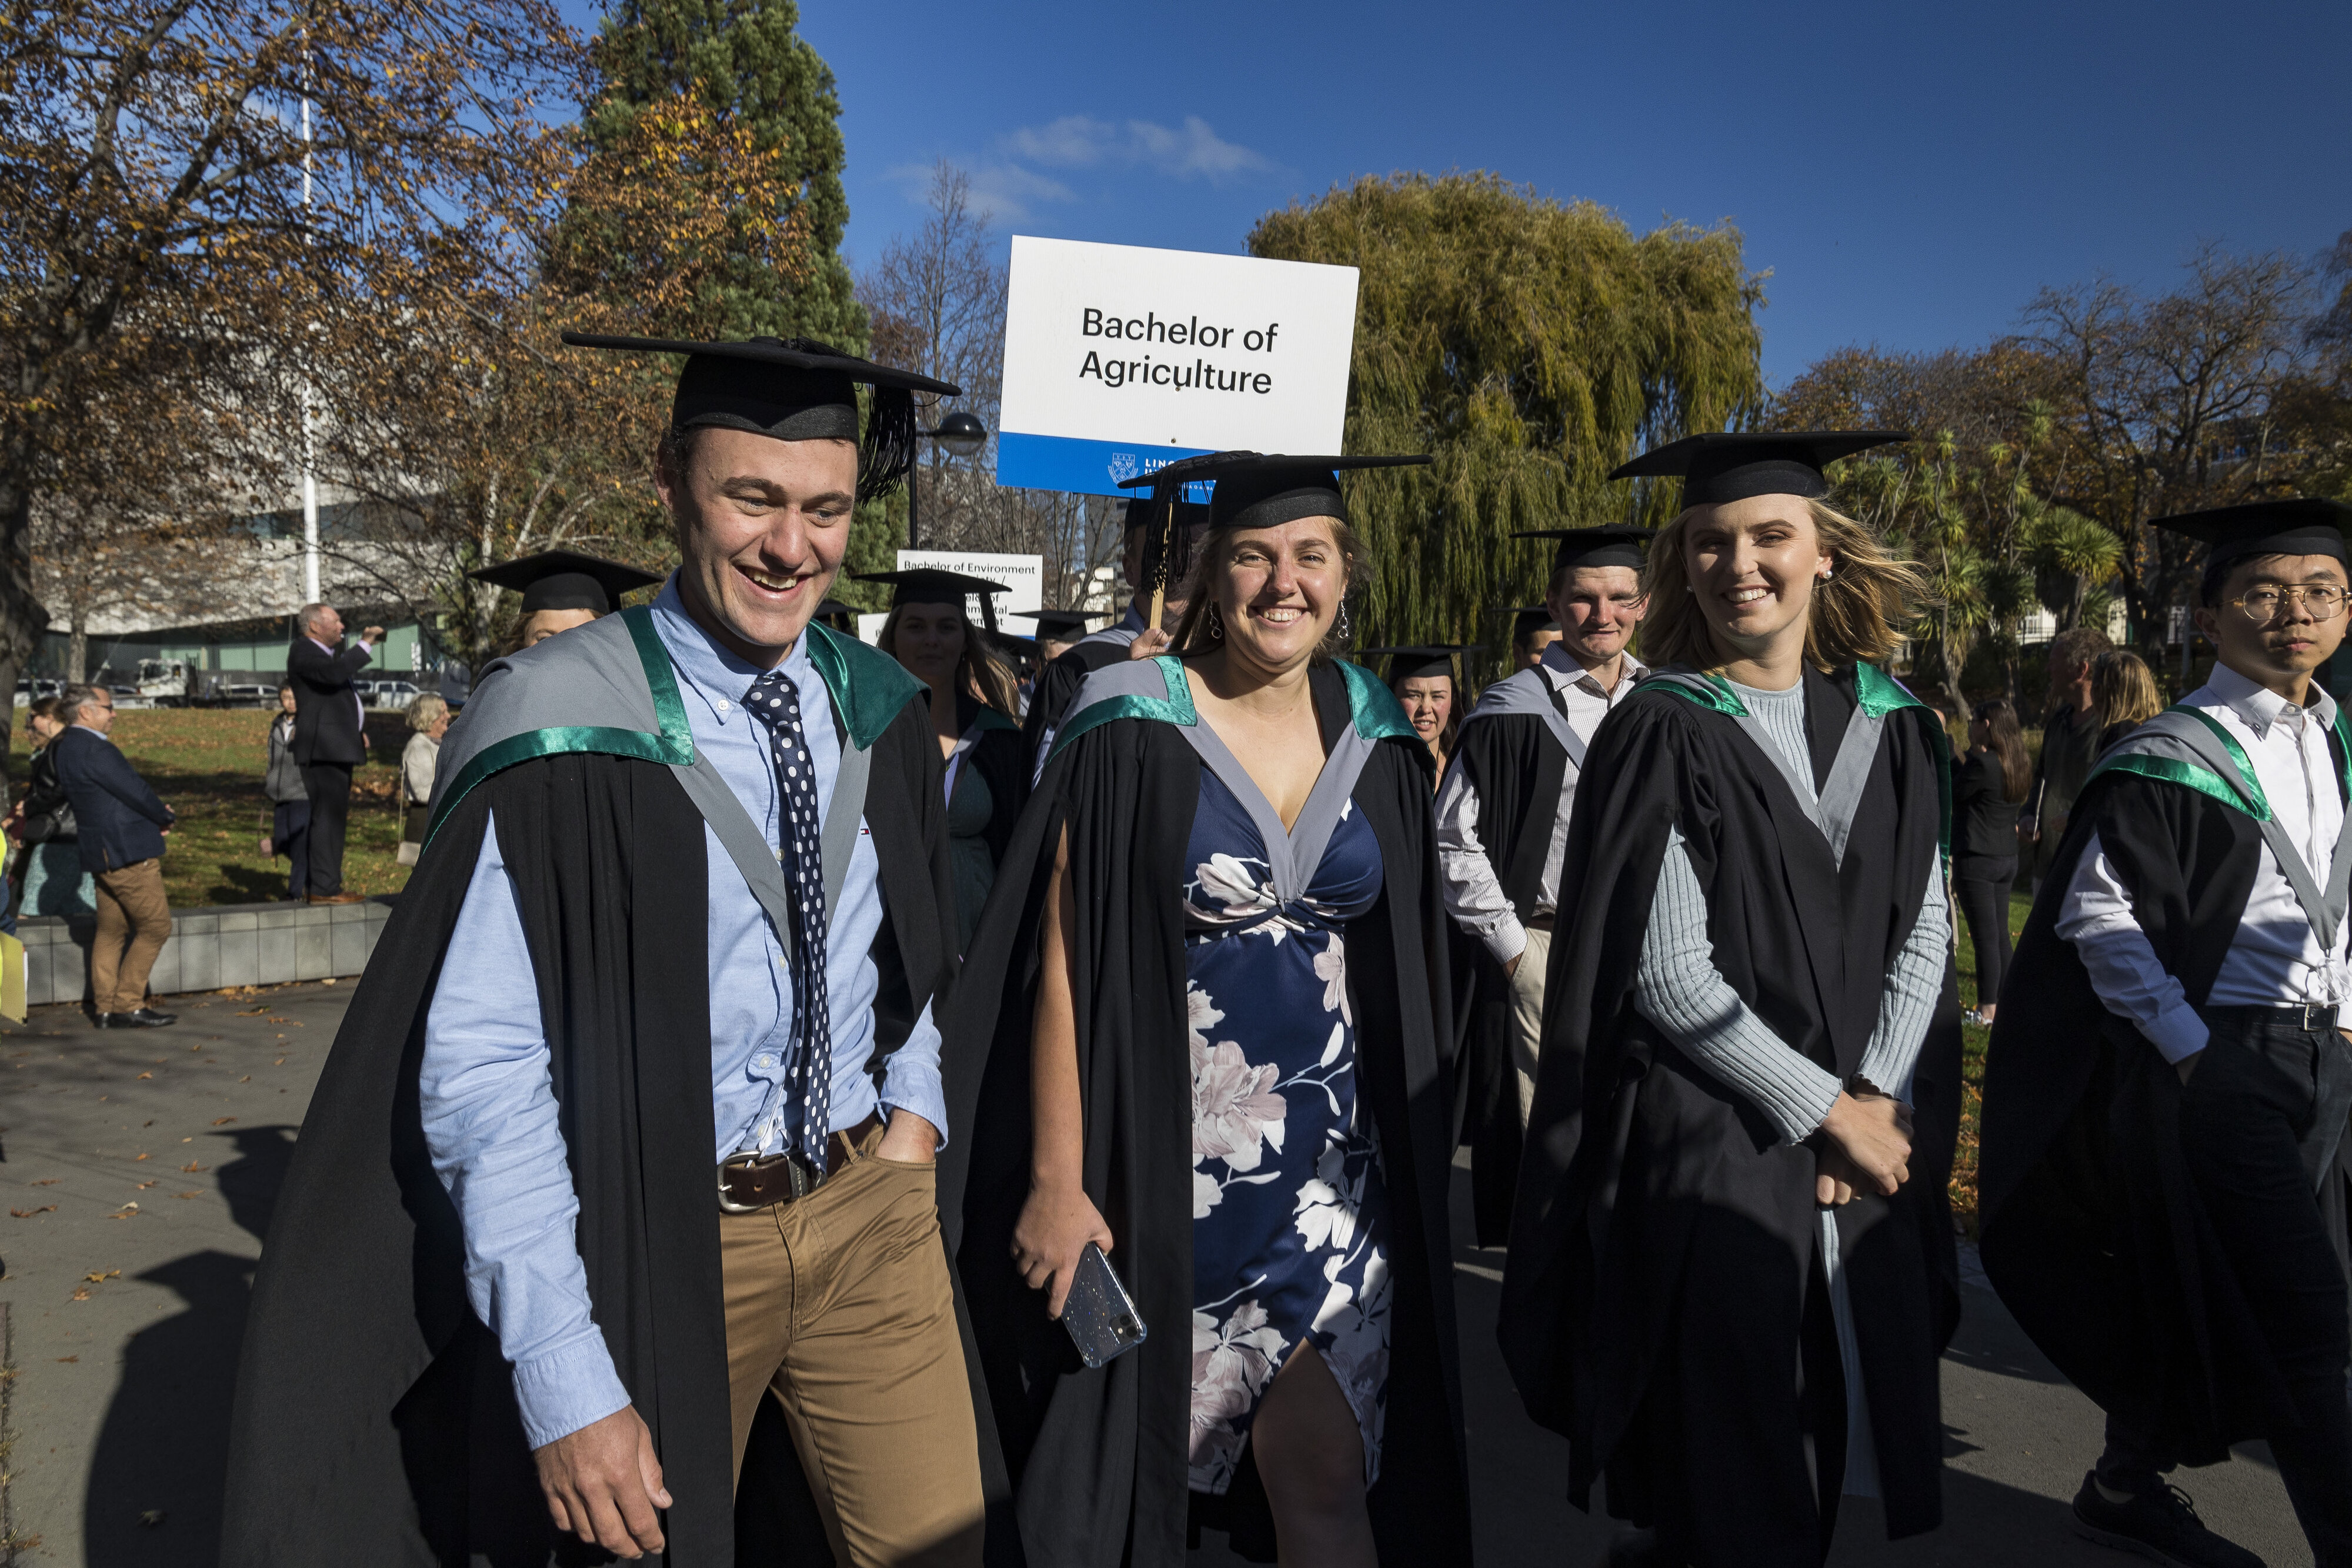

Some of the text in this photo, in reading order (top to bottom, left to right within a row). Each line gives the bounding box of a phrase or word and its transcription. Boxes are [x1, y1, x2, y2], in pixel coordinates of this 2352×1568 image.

[1082, 308, 1279, 352] Bachelor of
[1079, 351, 1272, 394] Agriculture
[954, 562, 965, 572] of
[968, 562, 1036, 574] Environment
